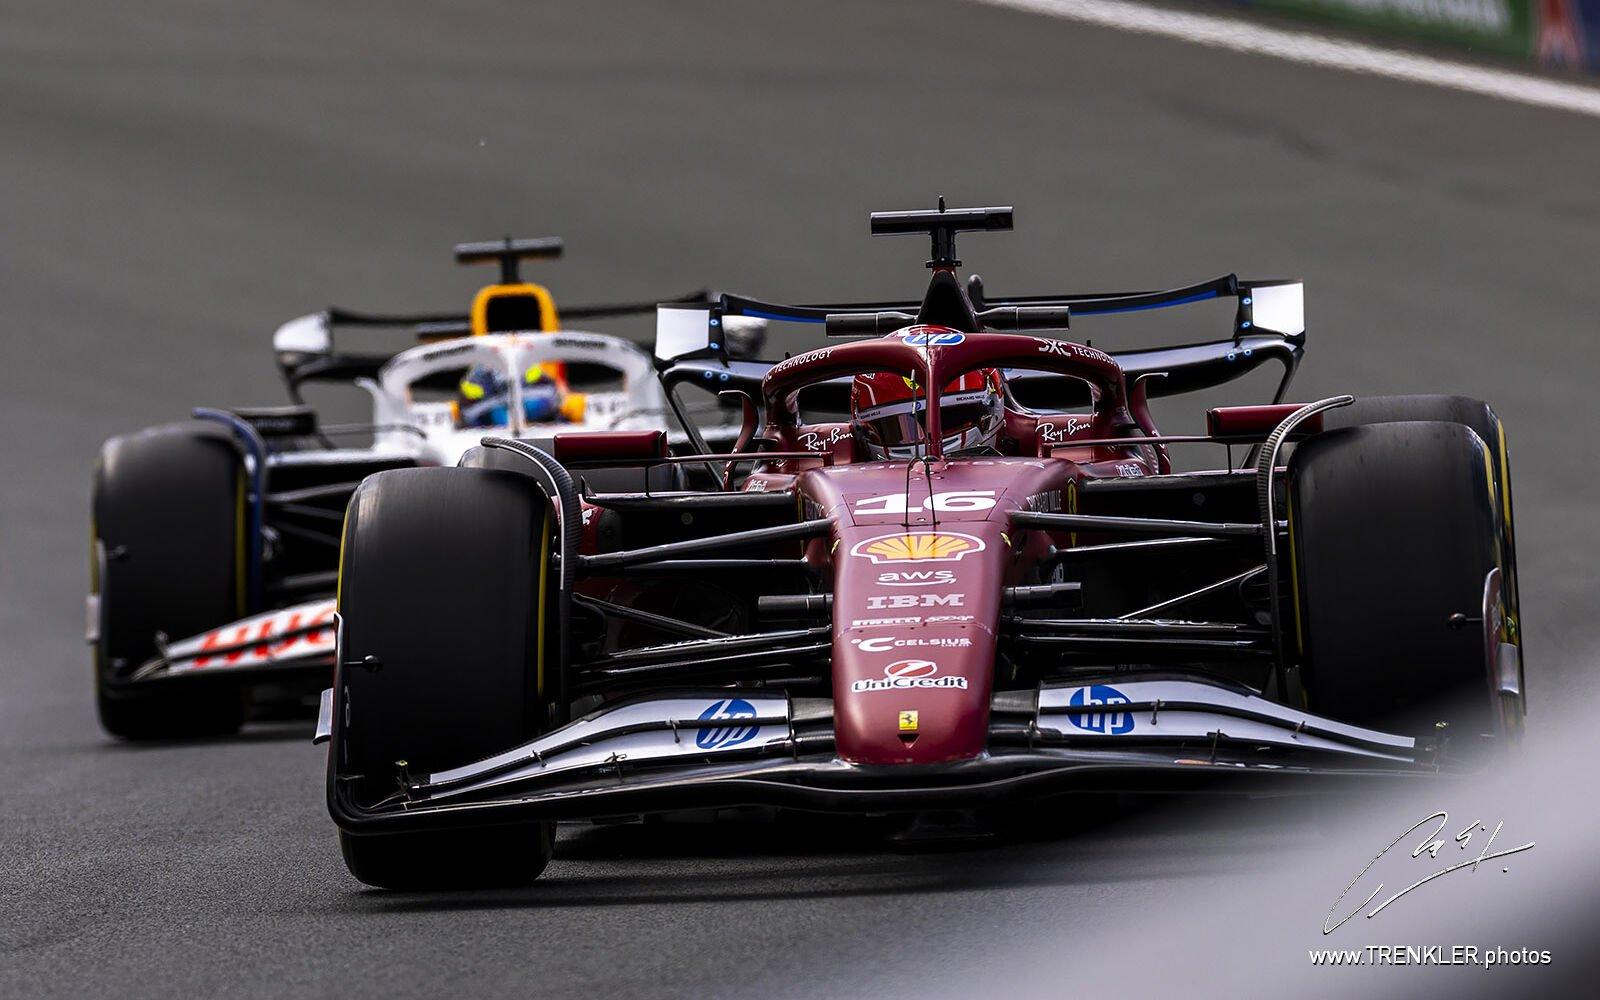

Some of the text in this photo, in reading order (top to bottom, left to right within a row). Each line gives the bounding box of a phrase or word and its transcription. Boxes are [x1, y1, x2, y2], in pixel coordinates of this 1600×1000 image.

[1034, 338, 1071, 357] DXC
[774, 348, 834, 373] TECHNOLOGY
[798, 427, 853, 451] Ray-Ban
[1035, 418, 1091, 442] Ray-Ban
[853, 490, 996, 516] 16
[876, 569, 956, 586] aws
[866, 593, 965, 610] IBM
[894, 638, 972, 647] CELSIUS
[852, 676, 968, 692] UniCredit
[1068, 685, 1135, 735] hp
[697, 699, 760, 750] hp
